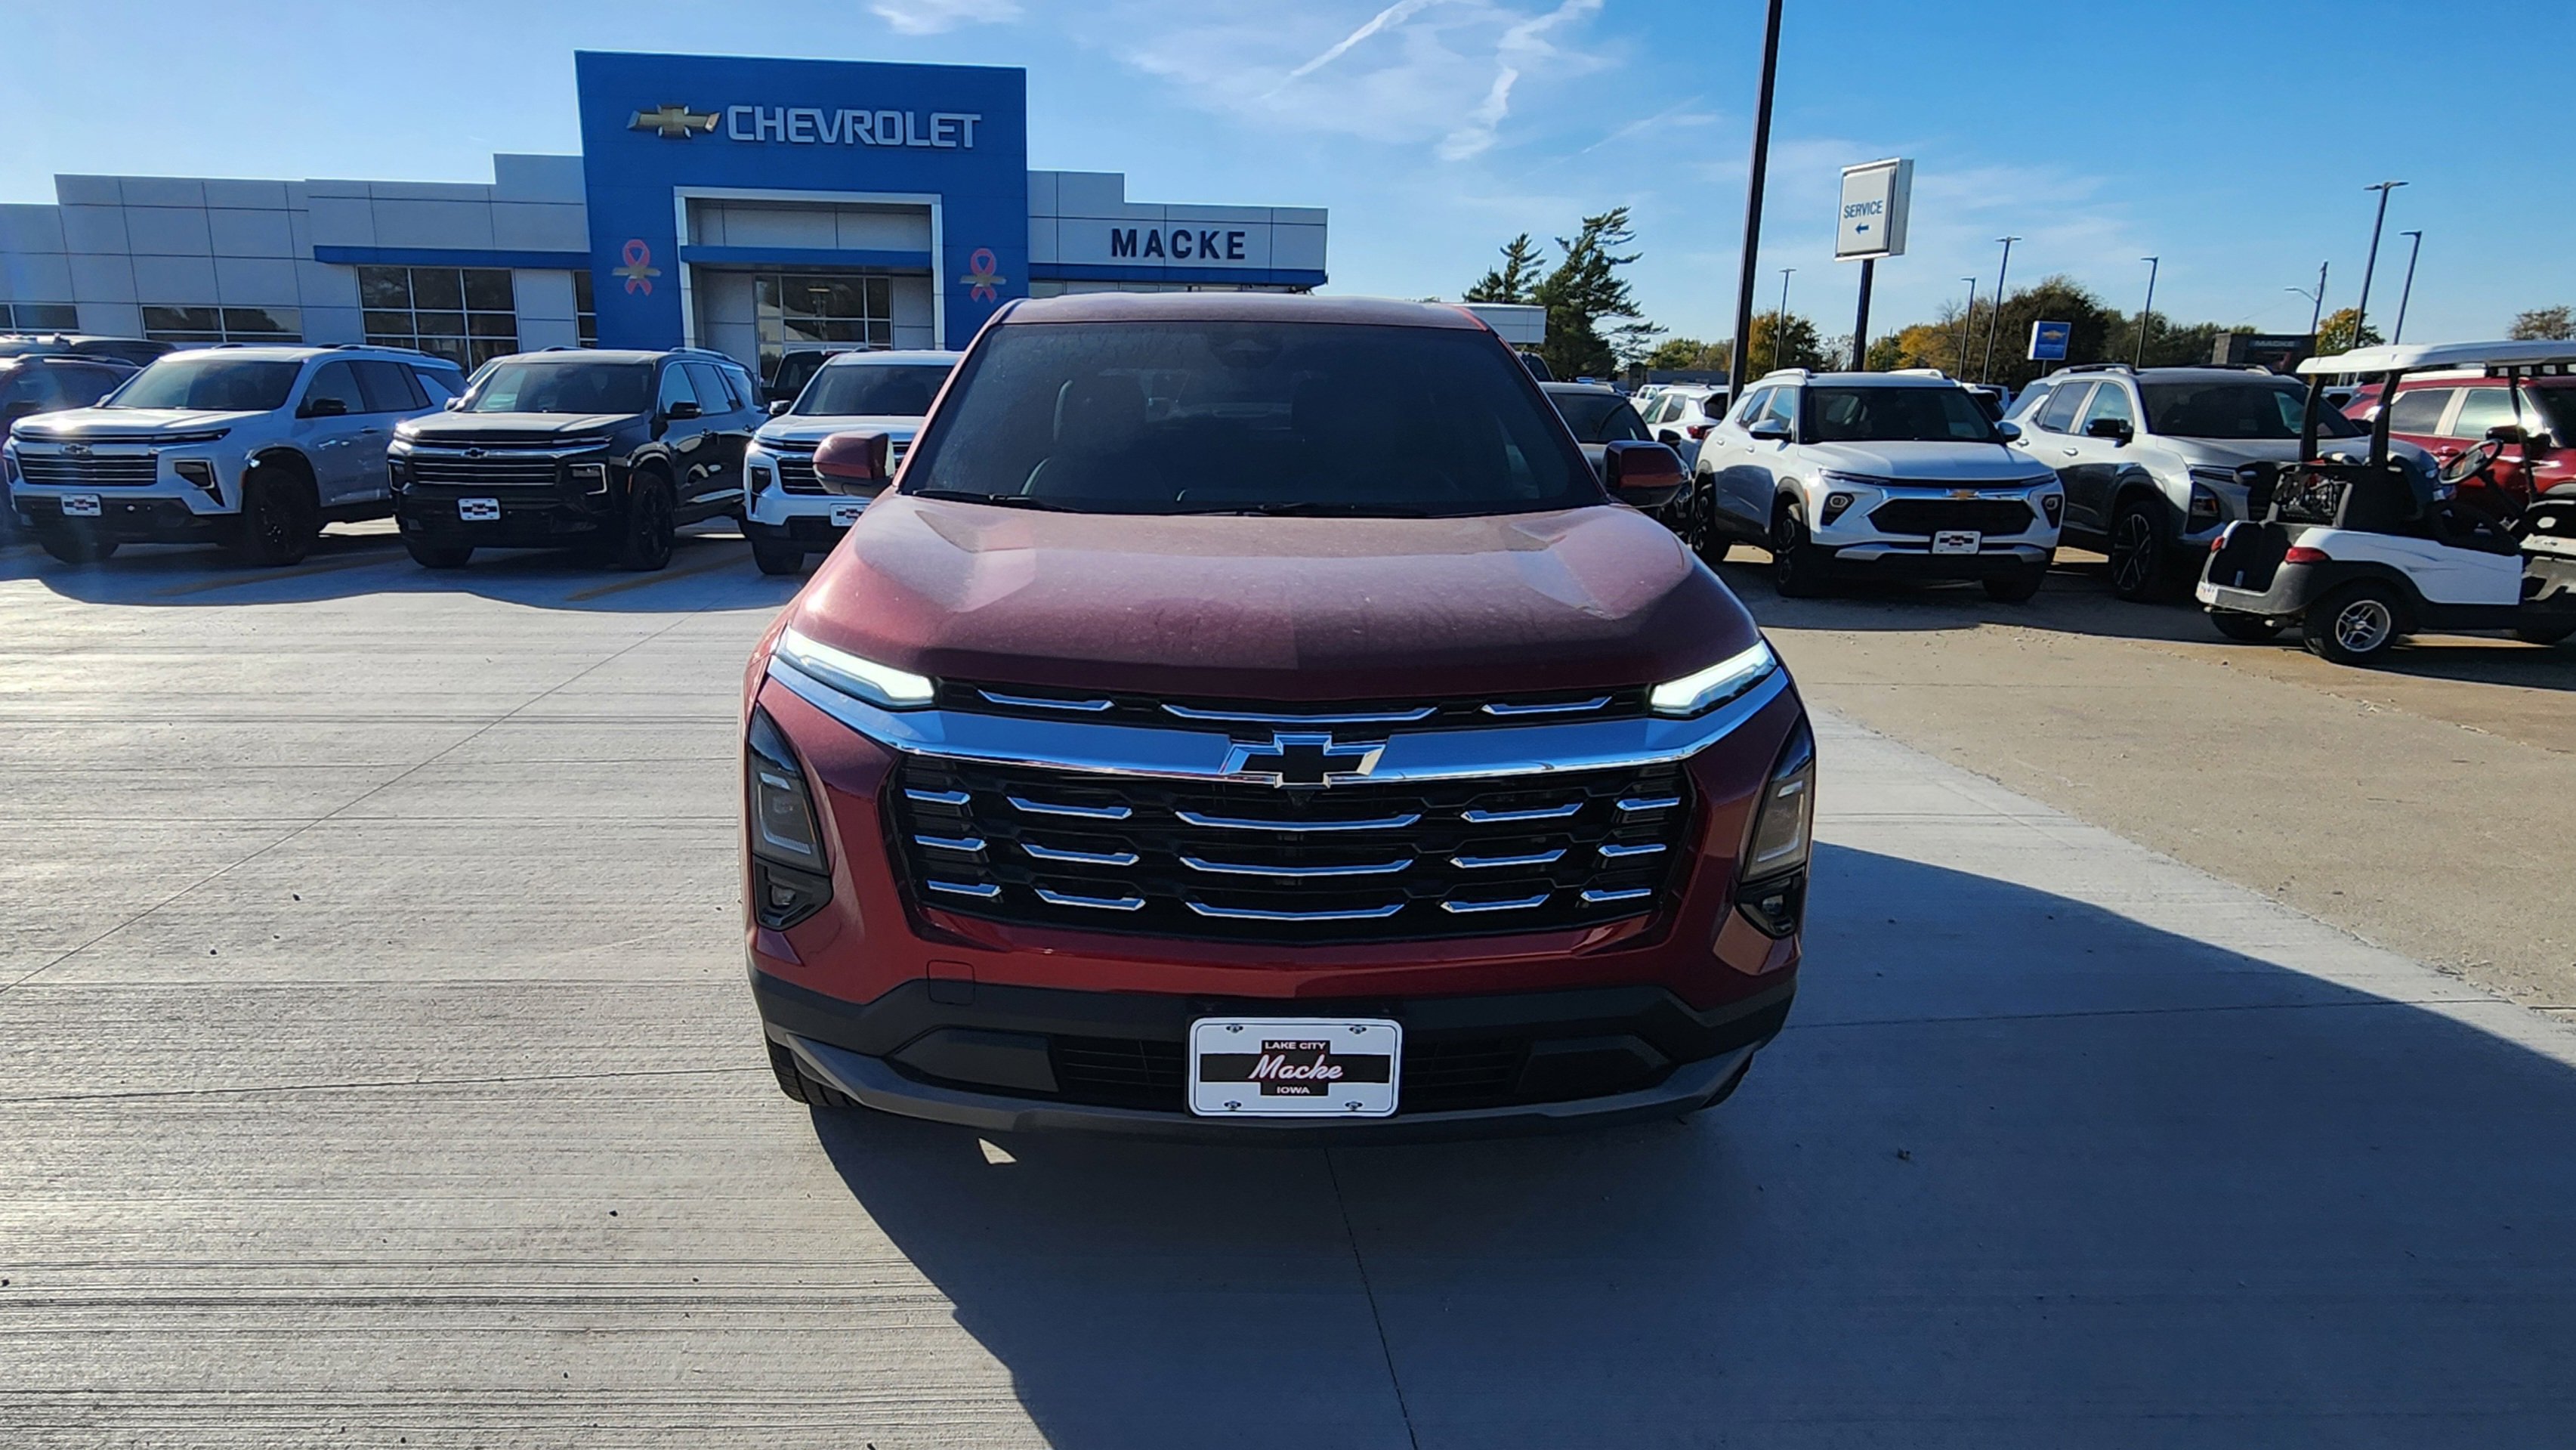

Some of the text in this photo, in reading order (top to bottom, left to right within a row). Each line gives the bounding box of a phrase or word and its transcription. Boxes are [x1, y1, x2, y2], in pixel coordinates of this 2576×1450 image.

[727, 105, 981, 147] CHEVROLET
[1844, 200, 1883, 218] SERVICE
[1111, 228, 1245, 259] MACKE
[1265, 1041, 1296, 1050] LAKE
[1248, 1054, 1343, 1080] Macke
[1276, 1086, 1310, 1094] IOWA
